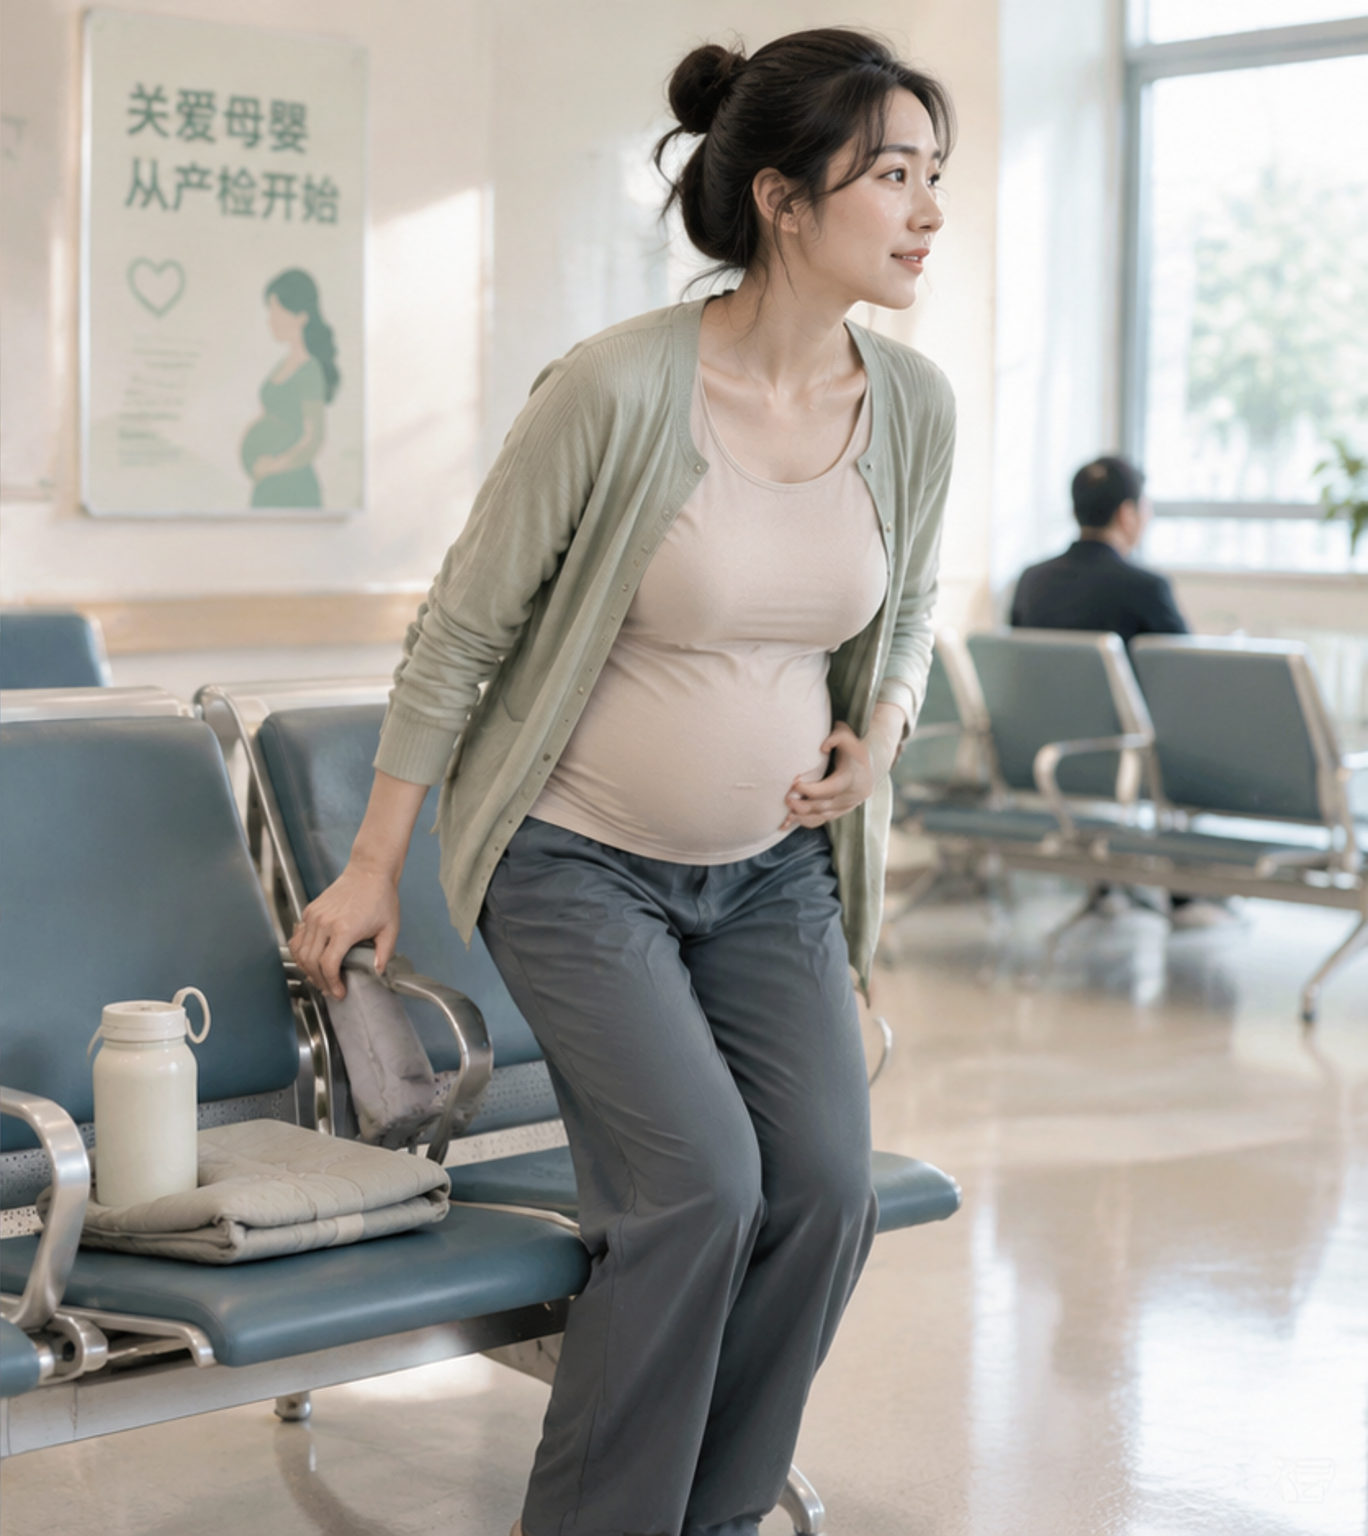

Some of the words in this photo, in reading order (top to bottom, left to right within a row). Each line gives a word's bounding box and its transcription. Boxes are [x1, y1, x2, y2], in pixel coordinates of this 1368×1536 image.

[126, 82, 310, 155] 关爱母婴
[124, 156, 340, 225] 从产检开始
